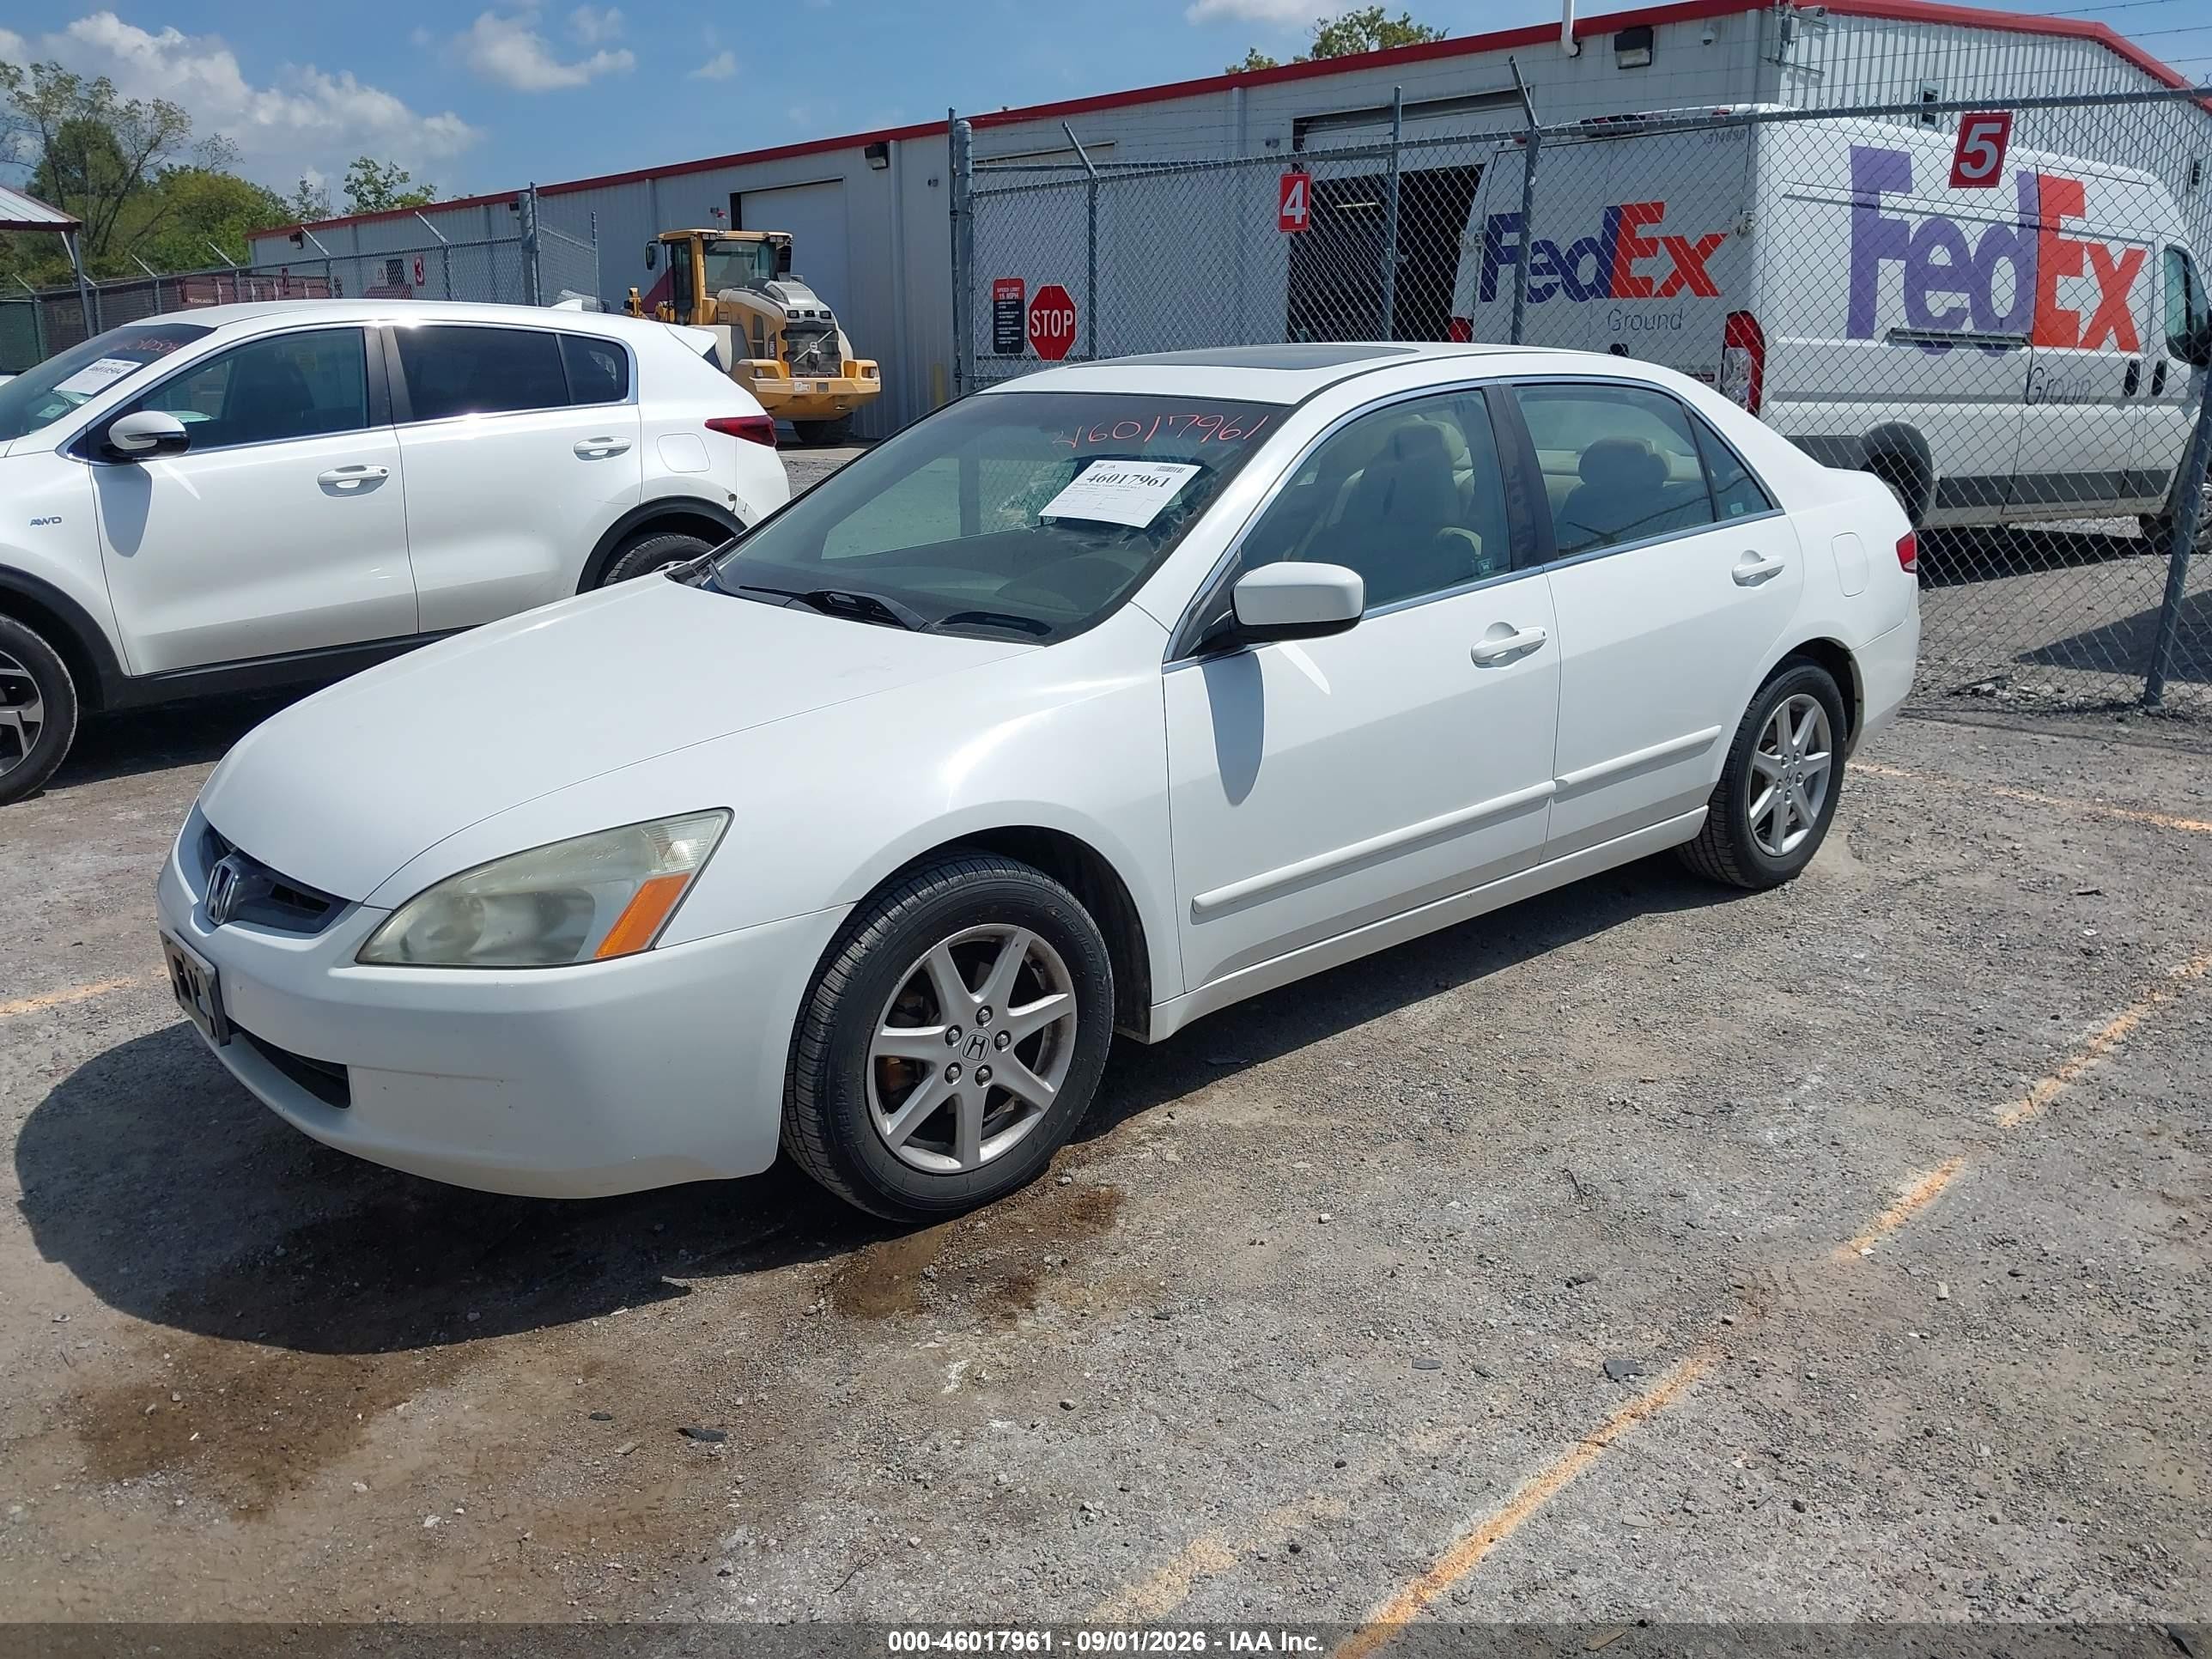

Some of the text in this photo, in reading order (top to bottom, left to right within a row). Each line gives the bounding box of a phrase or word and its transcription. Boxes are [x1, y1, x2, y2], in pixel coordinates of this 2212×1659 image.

[1959, 123, 2002, 179] 5
[1283, 180, 1306, 224] 4
[1480, 201, 1729, 303] FedEx
[1846, 145, 2148, 357] FedEx
[415, 258, 423, 283] 3
[1031, 309, 1073, 337] STOP
[1607, 308, 1683, 331] Ground
[2026, 367, 2104, 405] Groun
[1053, 415, 1269, 448] 46017961
[1085, 472, 1171, 488] 46017961
[29, 516, 63, 526] AWD
